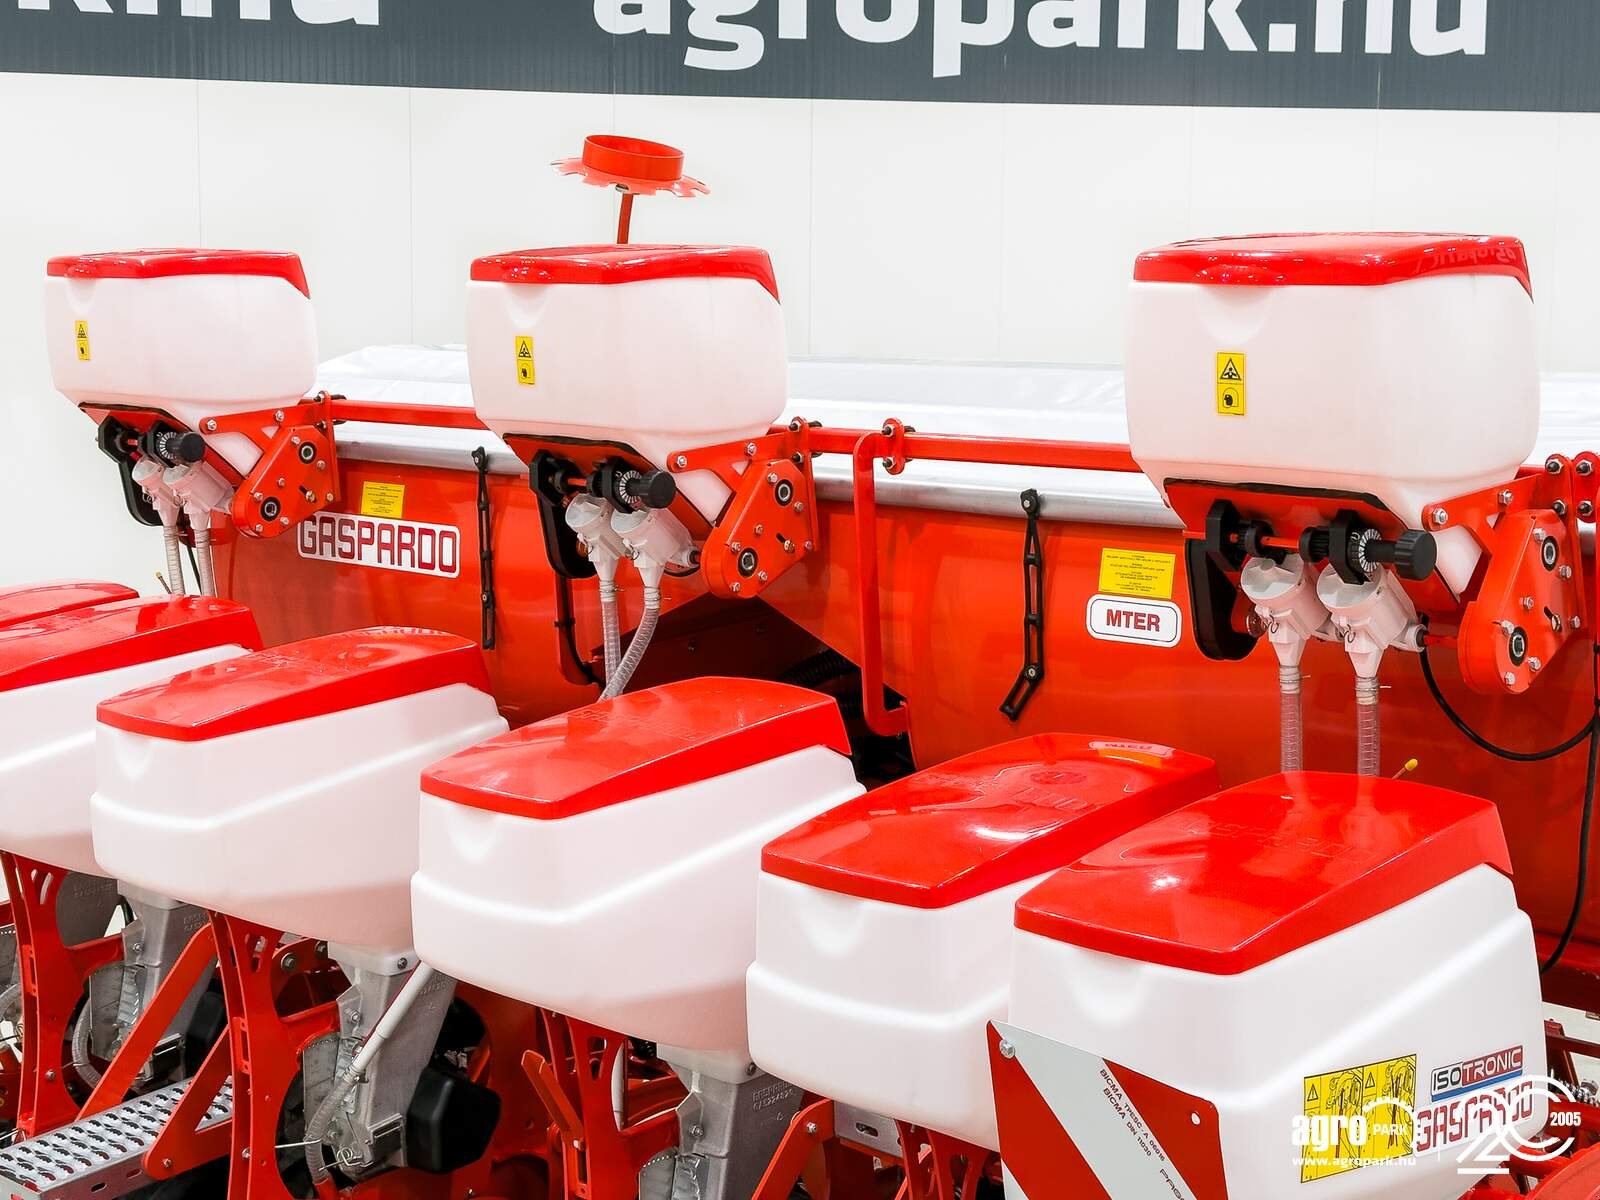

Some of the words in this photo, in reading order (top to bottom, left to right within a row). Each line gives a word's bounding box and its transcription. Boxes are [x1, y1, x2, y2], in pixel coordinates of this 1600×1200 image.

[300, 514, 457, 574] GASPARDO
[1106, 608, 1161, 632] MTER
[1100, 1069, 1122, 1100] BICMA
[1103, 1088, 1126, 1119] BICMA
[1126, 1121, 1137, 1136] DIN
[1137, 1136, 1152, 1157] 11030
